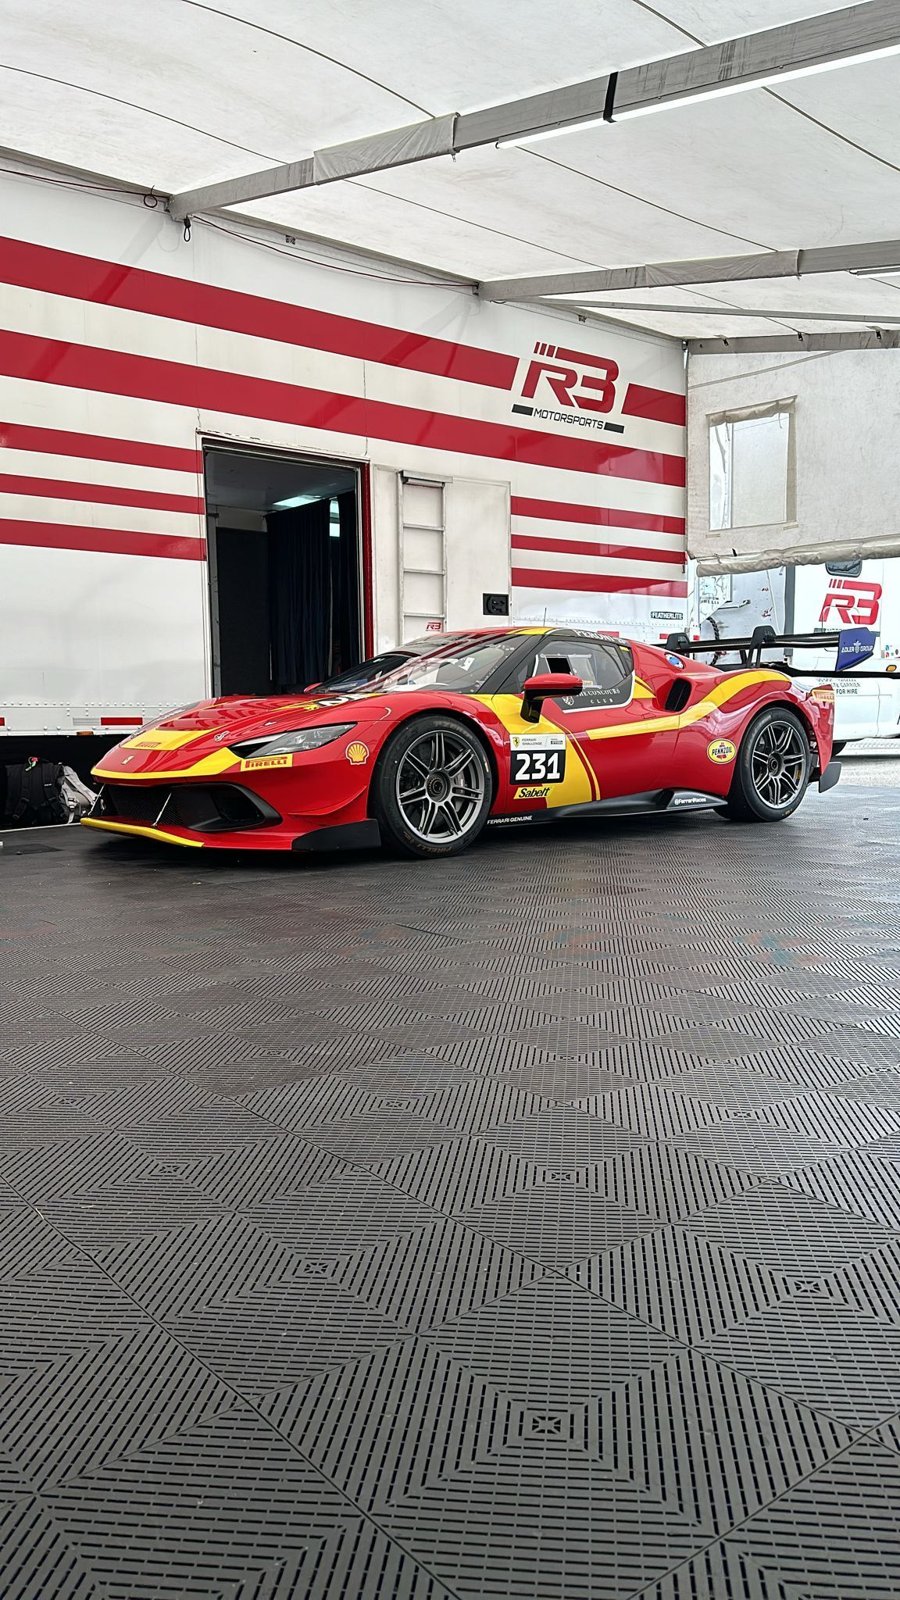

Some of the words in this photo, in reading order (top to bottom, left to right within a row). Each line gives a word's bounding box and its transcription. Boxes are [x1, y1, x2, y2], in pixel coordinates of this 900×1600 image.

[521, 341, 619, 414] R3
[533, 408, 604, 430] MOTORSPORTS
[819, 579, 883, 625] R3
[651, 611, 683, 620] FEATHERLITE
[841, 645, 855, 653] ADLER
[244, 756, 288, 769] PIRELLI
[515, 752, 561, 780] 231
[518, 787, 551, 798] Sabelt
[486, 817, 510, 825] FERRARI
[510, 815, 533, 823] GENUINE
